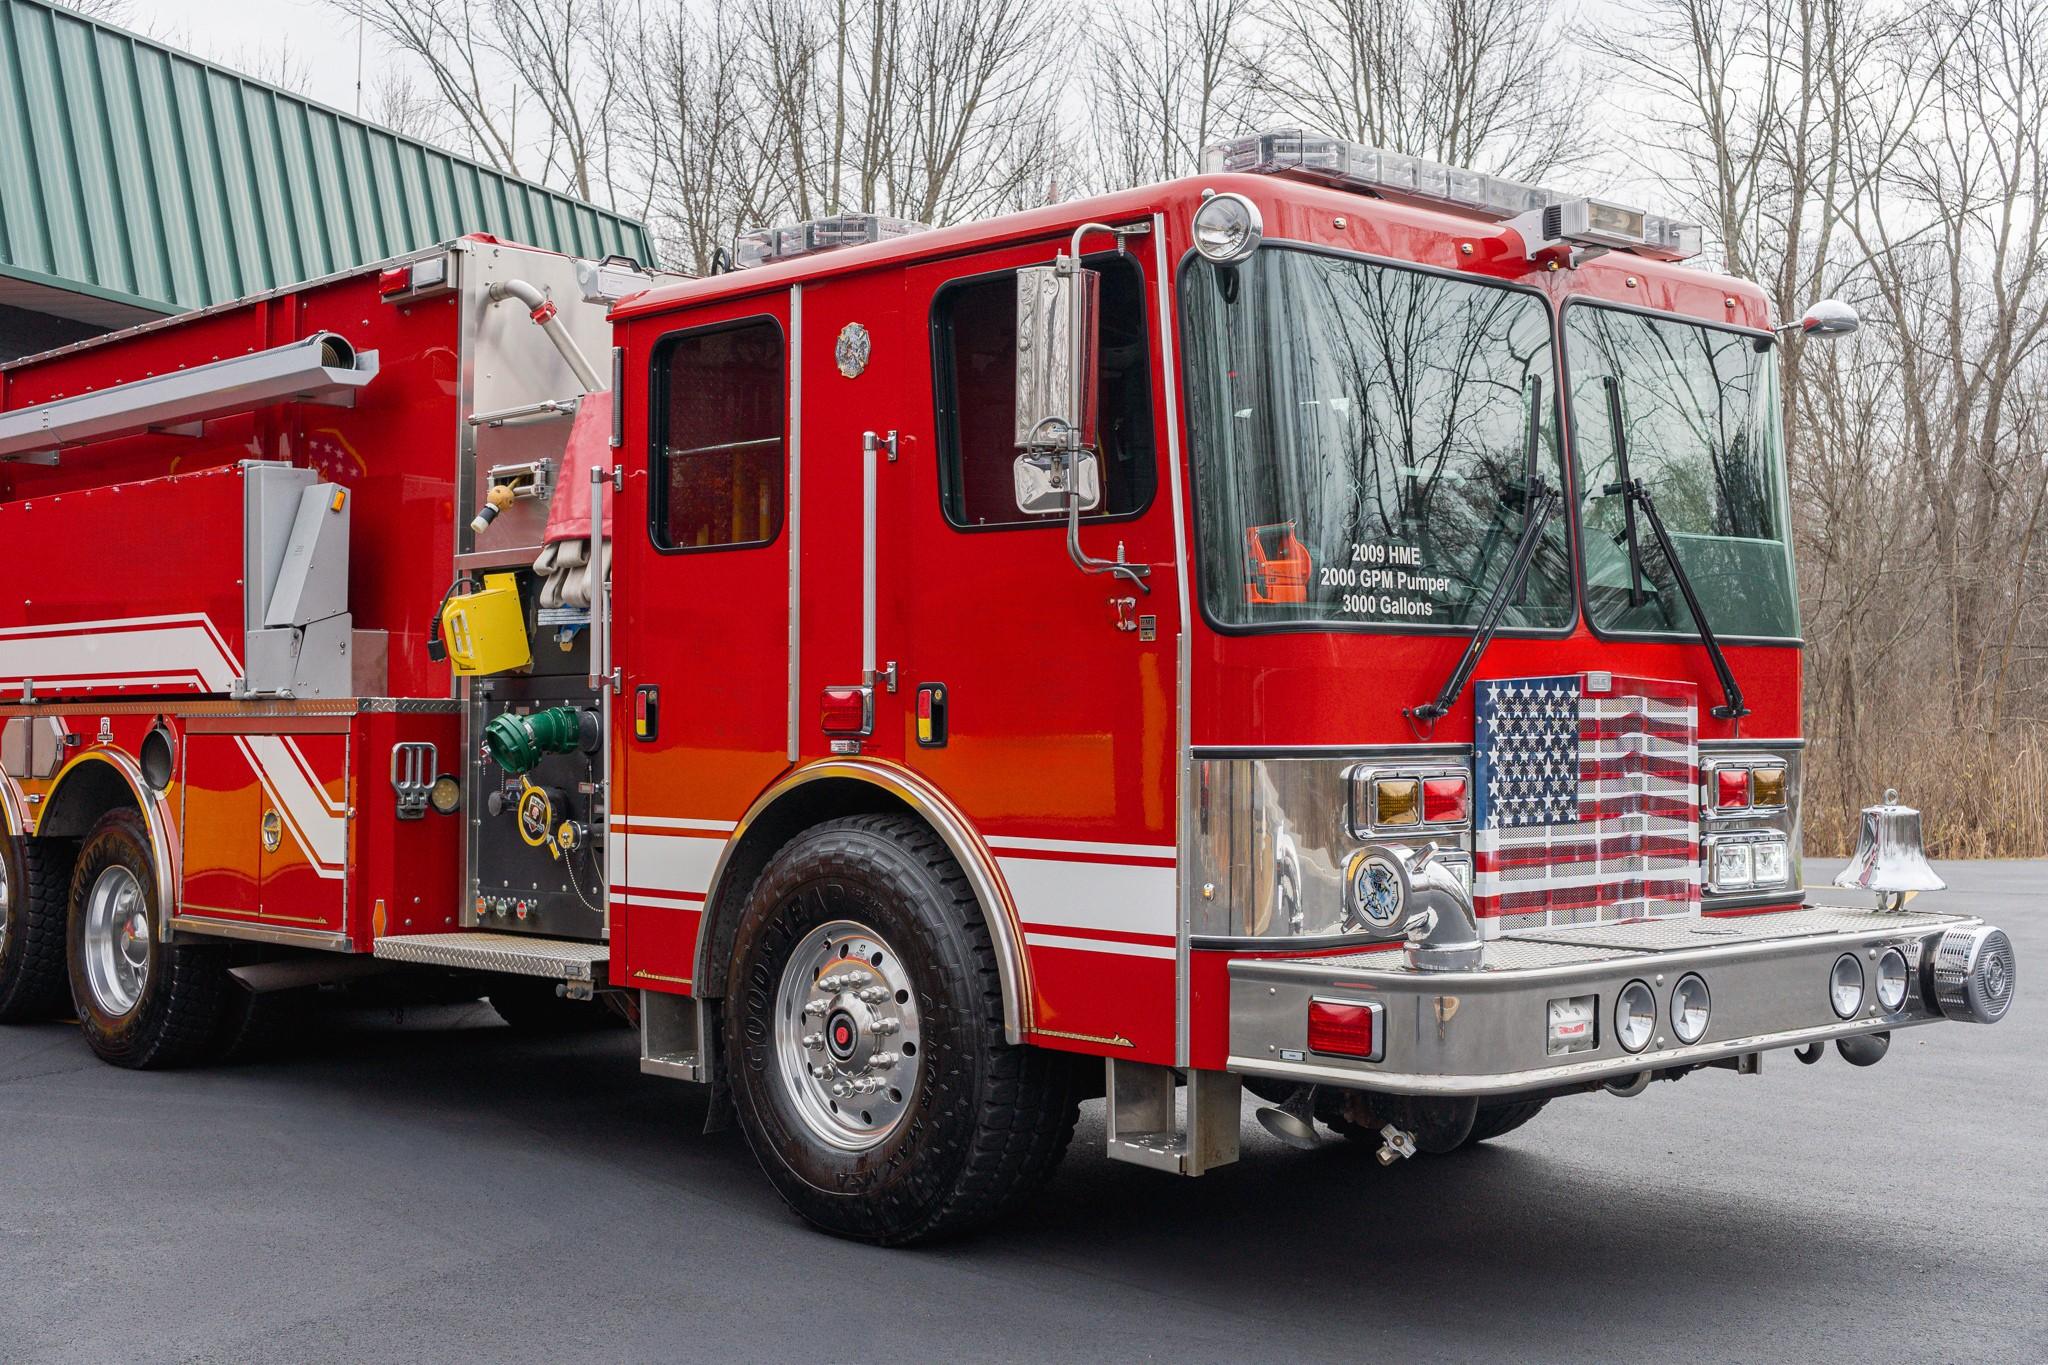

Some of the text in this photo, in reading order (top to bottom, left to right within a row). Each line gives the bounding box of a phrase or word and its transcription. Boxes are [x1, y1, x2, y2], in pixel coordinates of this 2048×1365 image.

[1351, 543, 1421, 566] 2009 HME
[1320, 567, 1450, 595] 2000 GPM Pumper
[1342, 594, 1433, 616] 3000 Gallons
